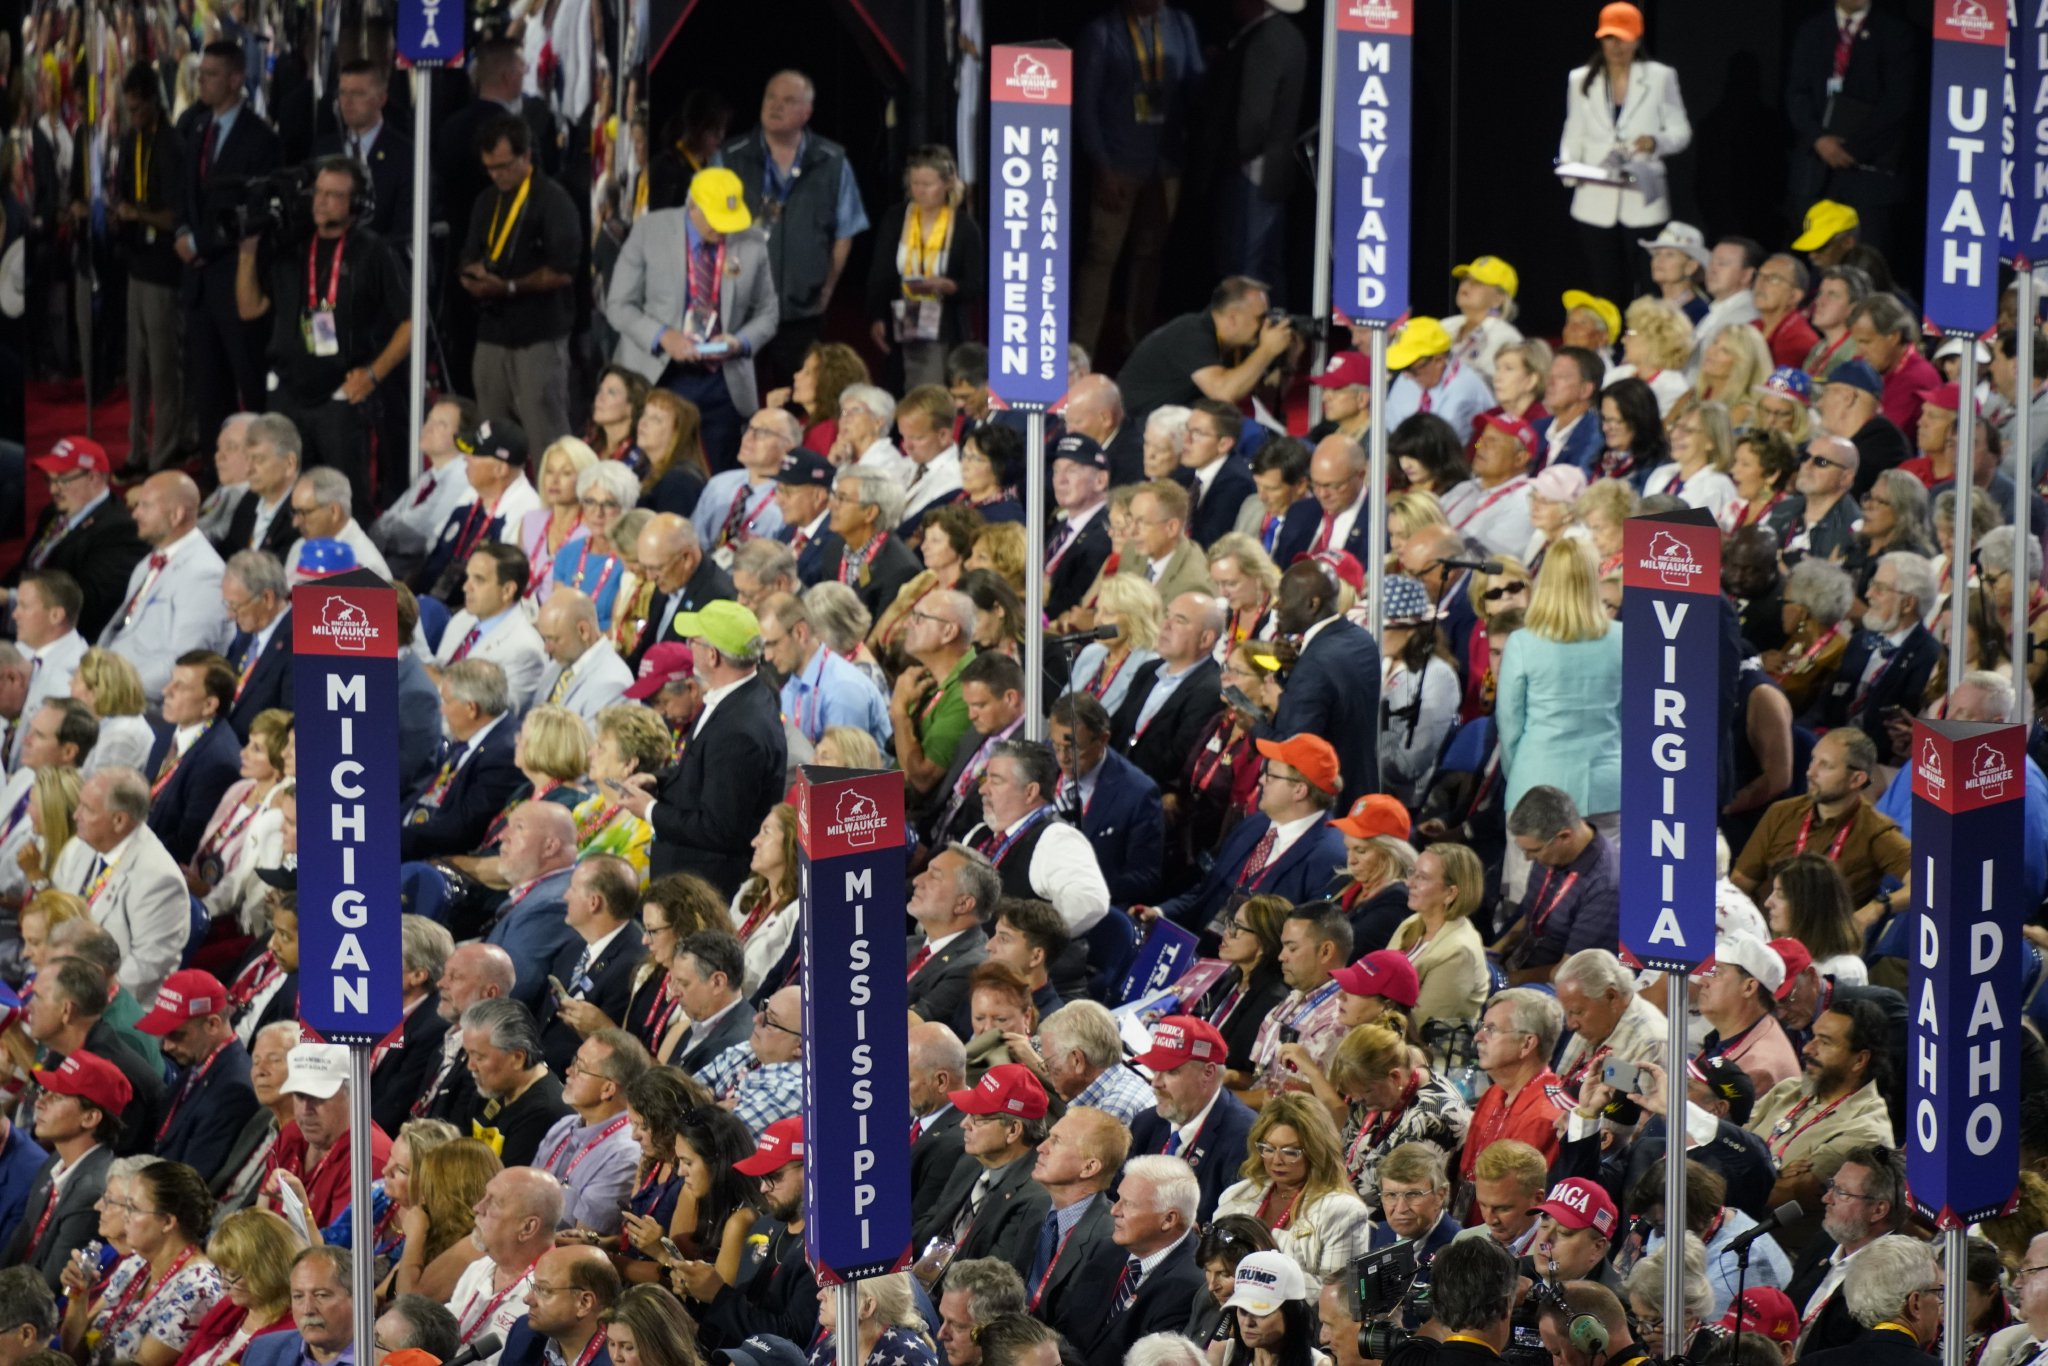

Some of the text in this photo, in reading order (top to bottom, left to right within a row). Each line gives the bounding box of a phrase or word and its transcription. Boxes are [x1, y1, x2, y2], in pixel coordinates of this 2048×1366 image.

[1002, 125, 1031, 375] NORTHERN
[1040, 128, 1059, 380] MARIANA ISLANDS
[1357, 41, 1390, 308] MARYLAND
[1941, 85, 1988, 287] UTAH
[312, 625, 379, 637] MILWAUKEE
[1640, 559, 1703, 574] MILWAUKEE
[327, 673, 370, 1014] MICHIGAN
[827, 817, 887, 836] MILWAUKEE
[1648, 600, 1689, 947] VIRGINIA
[1966, 769, 2013, 789] MILWAUKEE
[802, 864, 813, 1245] MISSISSIPPI
[845, 868, 876, 1250] MISSISSIPPI
[1159, 1022, 1185, 1039] MERICA
[1917, 855, 1939, 1153] IDAHO
[1966, 859, 2004, 1156] IDAHO
[1216, 1313, 1231, 1337] TRUMP
[1237, 1268, 1277, 1285] TRUMP
